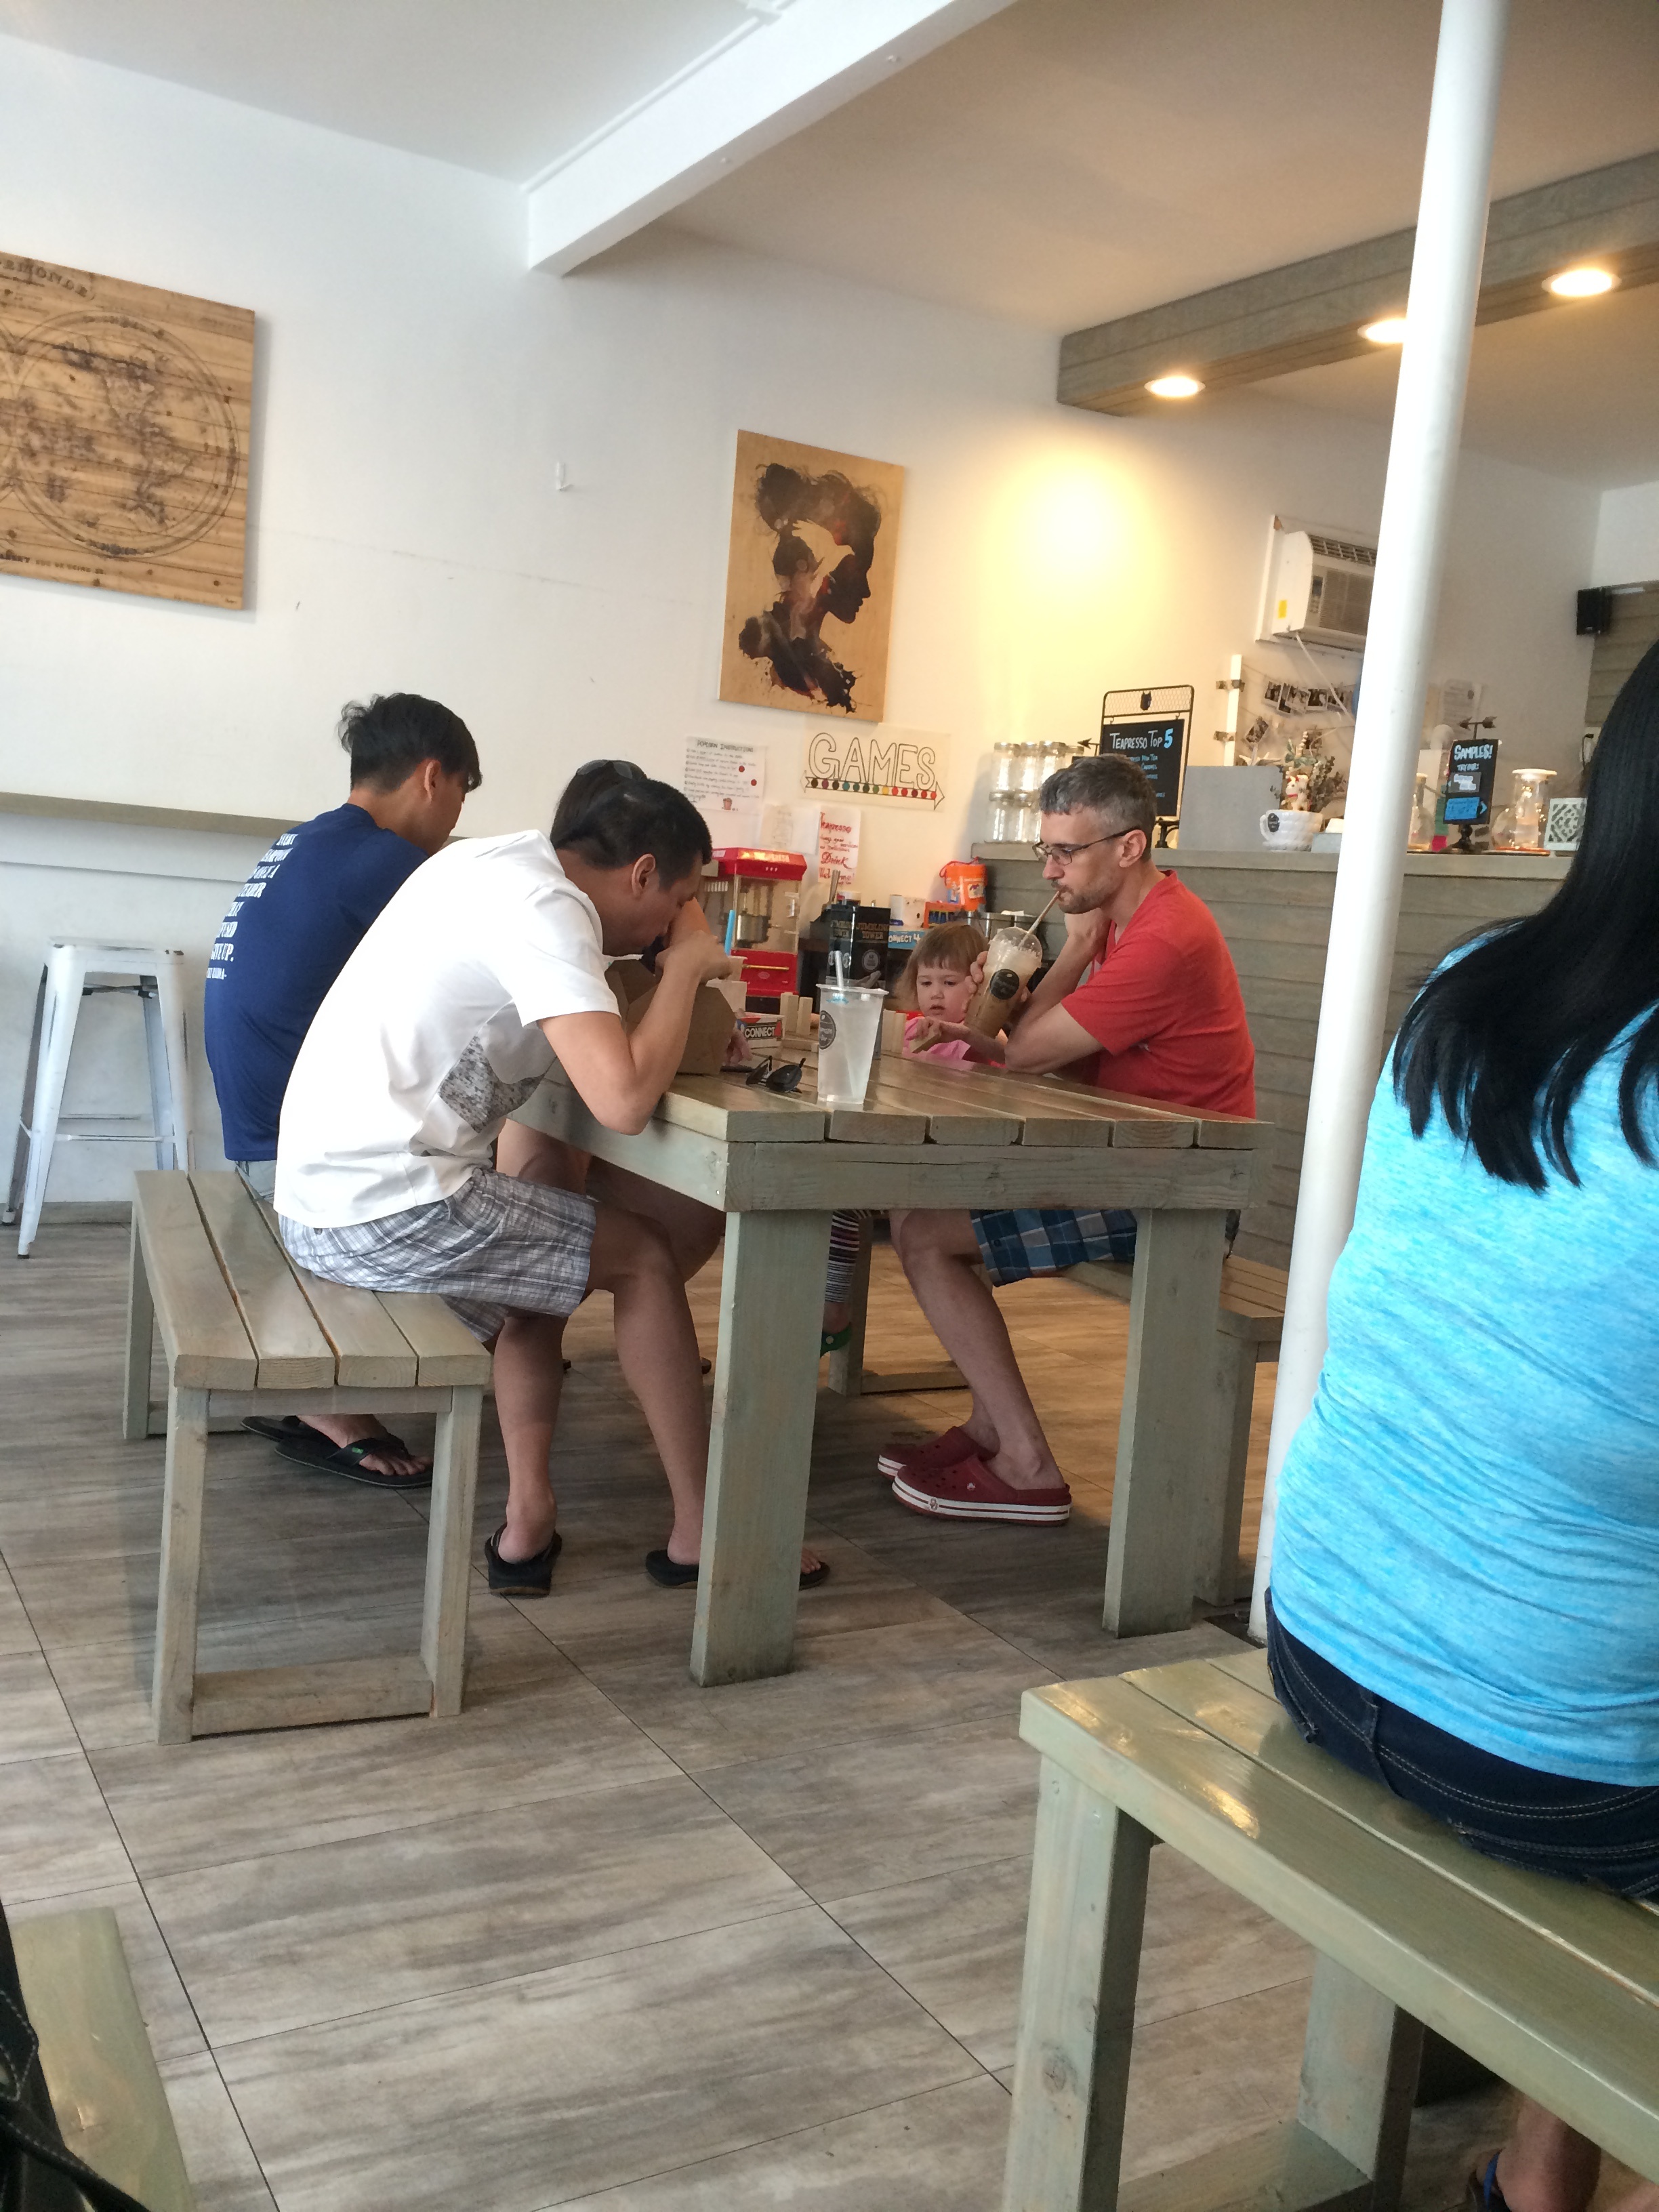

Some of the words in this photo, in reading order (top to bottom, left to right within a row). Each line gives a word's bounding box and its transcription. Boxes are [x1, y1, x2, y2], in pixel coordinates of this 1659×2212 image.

[1109, 733, 1147, 750] TEAPRESSO
[1164, 728, 1174, 749] 5
[1454, 744, 1494, 760] SAMPLES!
[808, 732, 935, 791] GAMES
[862, 931, 884, 939] TOWER
[745, 1027, 775, 1038] CONNECT
